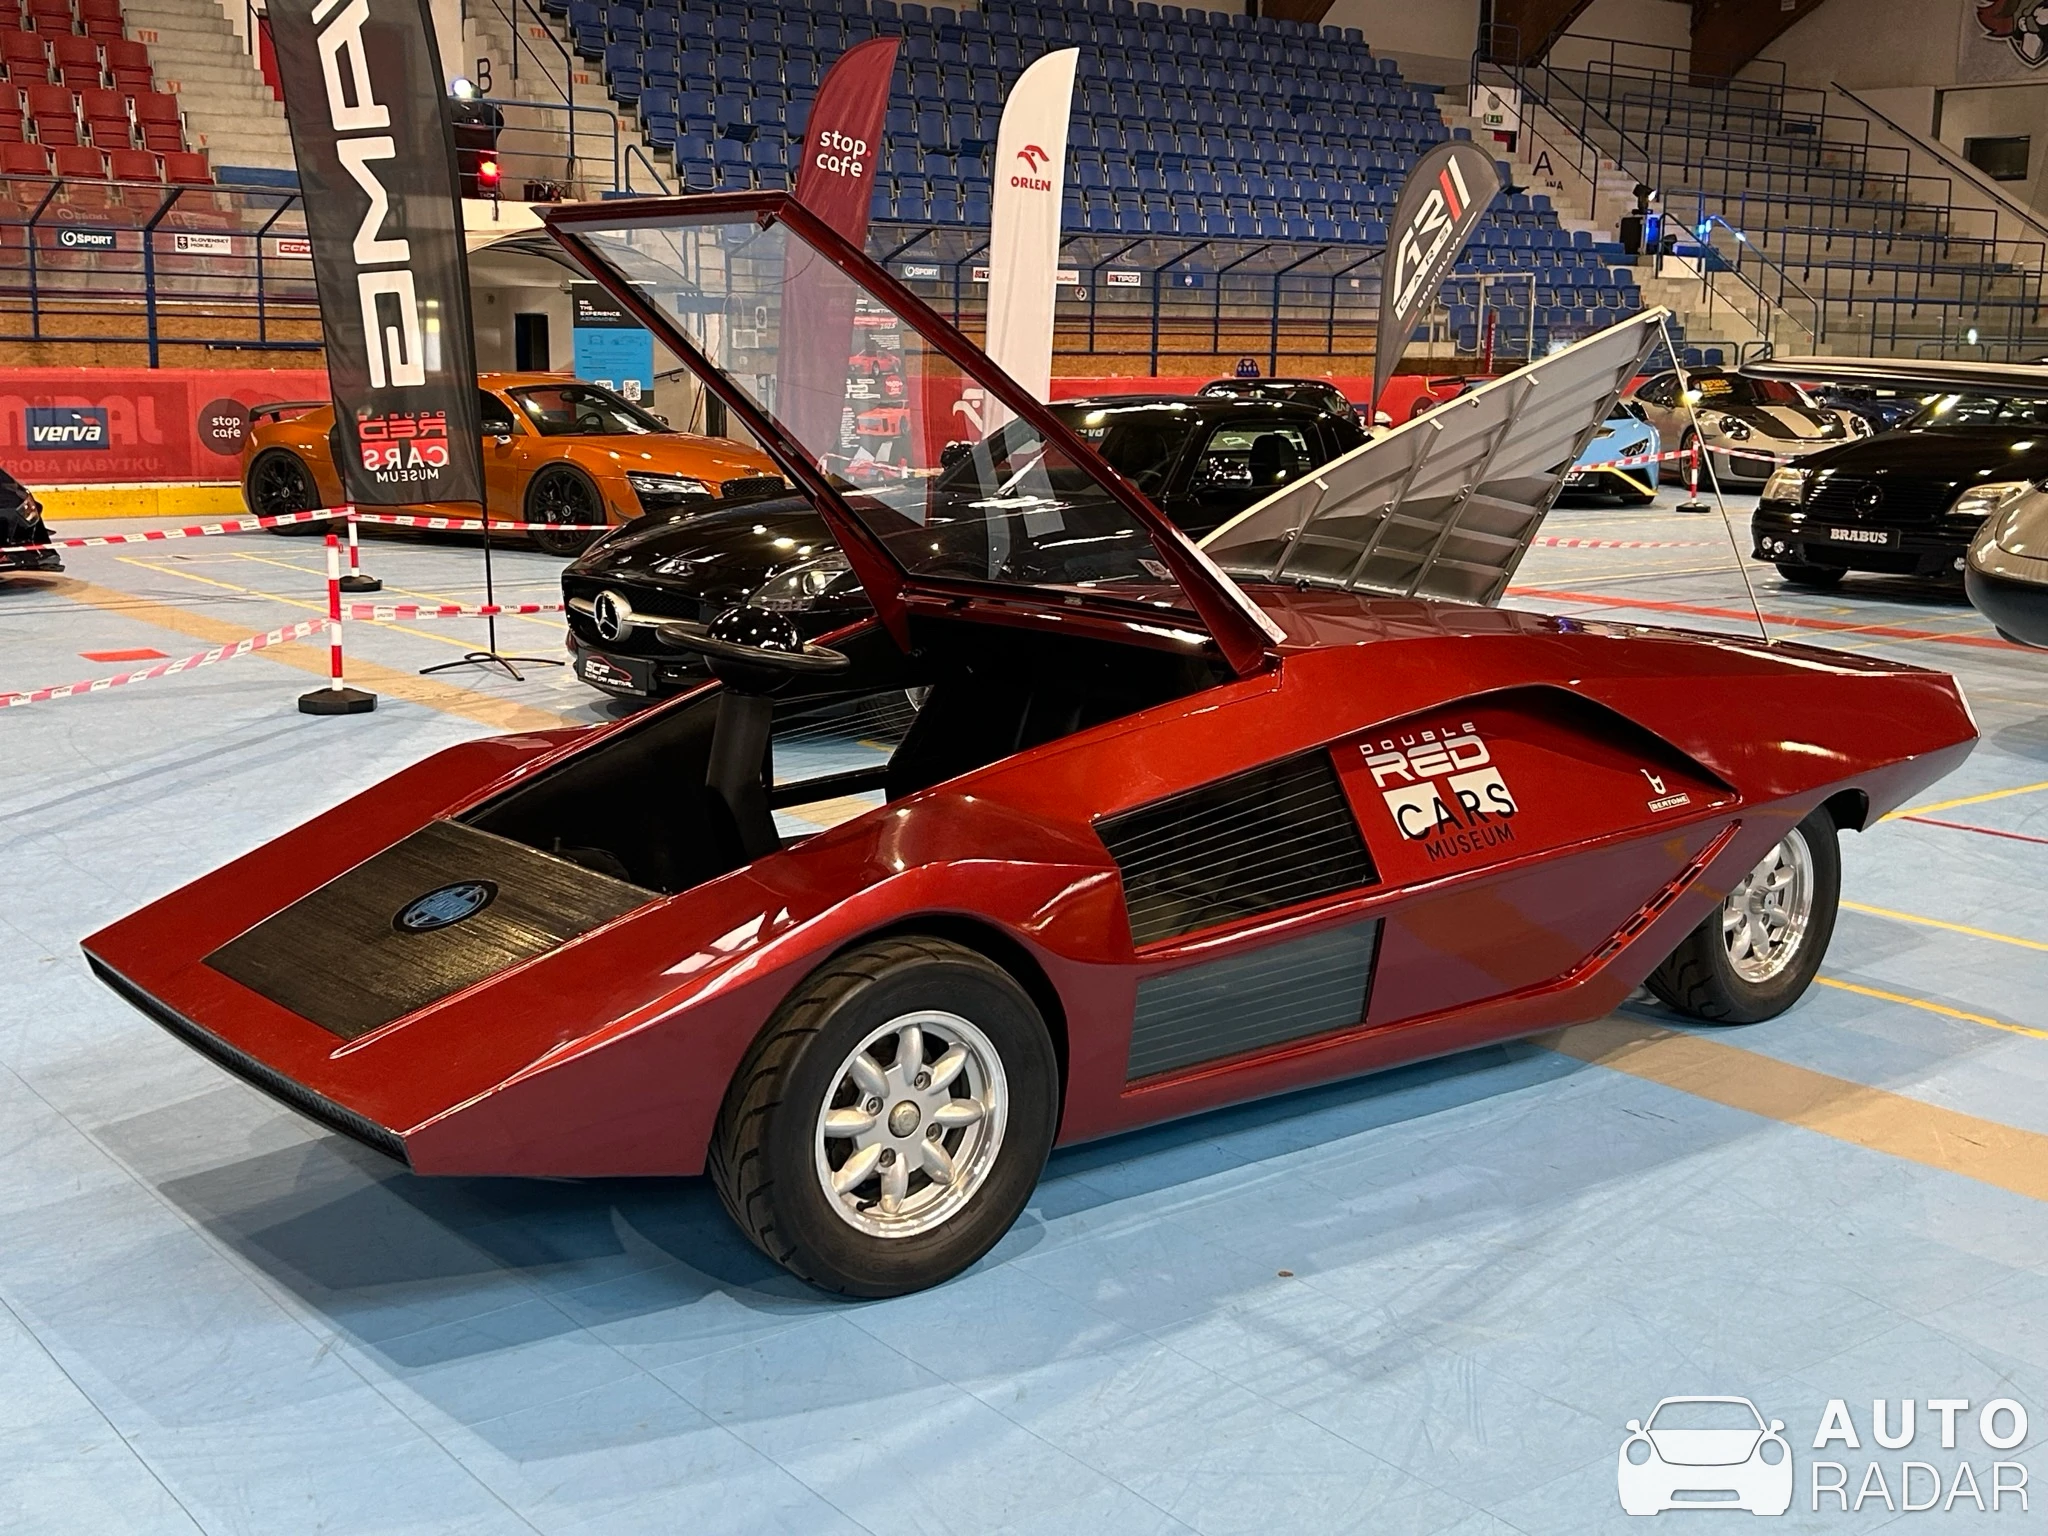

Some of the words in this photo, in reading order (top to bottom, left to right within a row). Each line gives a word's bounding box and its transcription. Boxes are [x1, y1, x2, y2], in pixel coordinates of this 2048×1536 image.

[816, 153, 863, 178] cafe
[1532, 150, 1554, 176] A
[1010, 175, 1052, 192] ORLEN
[1417, 236, 1461, 309] BRATISLAVA
[33, 424, 102, 443] verva
[212, 427, 241, 439] cafe
[1830, 528, 1888, 544] BRABUS
[1359, 722, 1476, 756] DOUBLE
[1365, 734, 1491, 788] RED
[1397, 783, 1515, 841] CARS
[1650, 795, 1689, 810] BERTONE
[1425, 822, 1515, 863] MUSEUM
